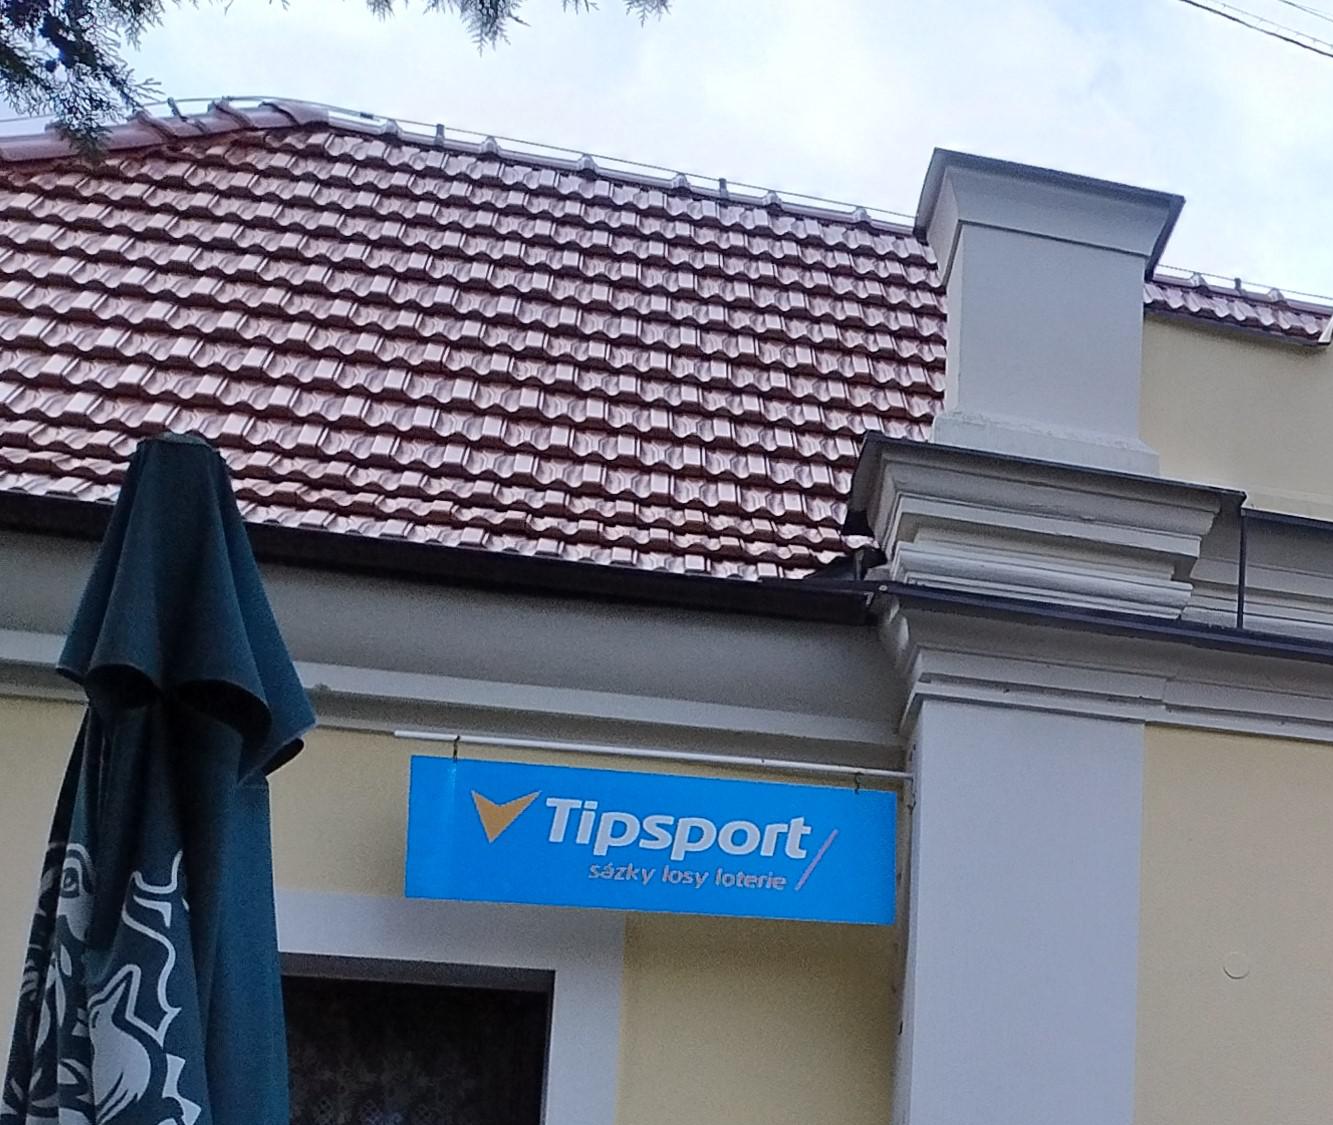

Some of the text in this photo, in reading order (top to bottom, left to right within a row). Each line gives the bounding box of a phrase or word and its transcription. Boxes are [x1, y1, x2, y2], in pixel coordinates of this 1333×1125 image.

[547, 797, 812, 861] Tipsport
[588, 862, 787, 890] sázky losy loterie
